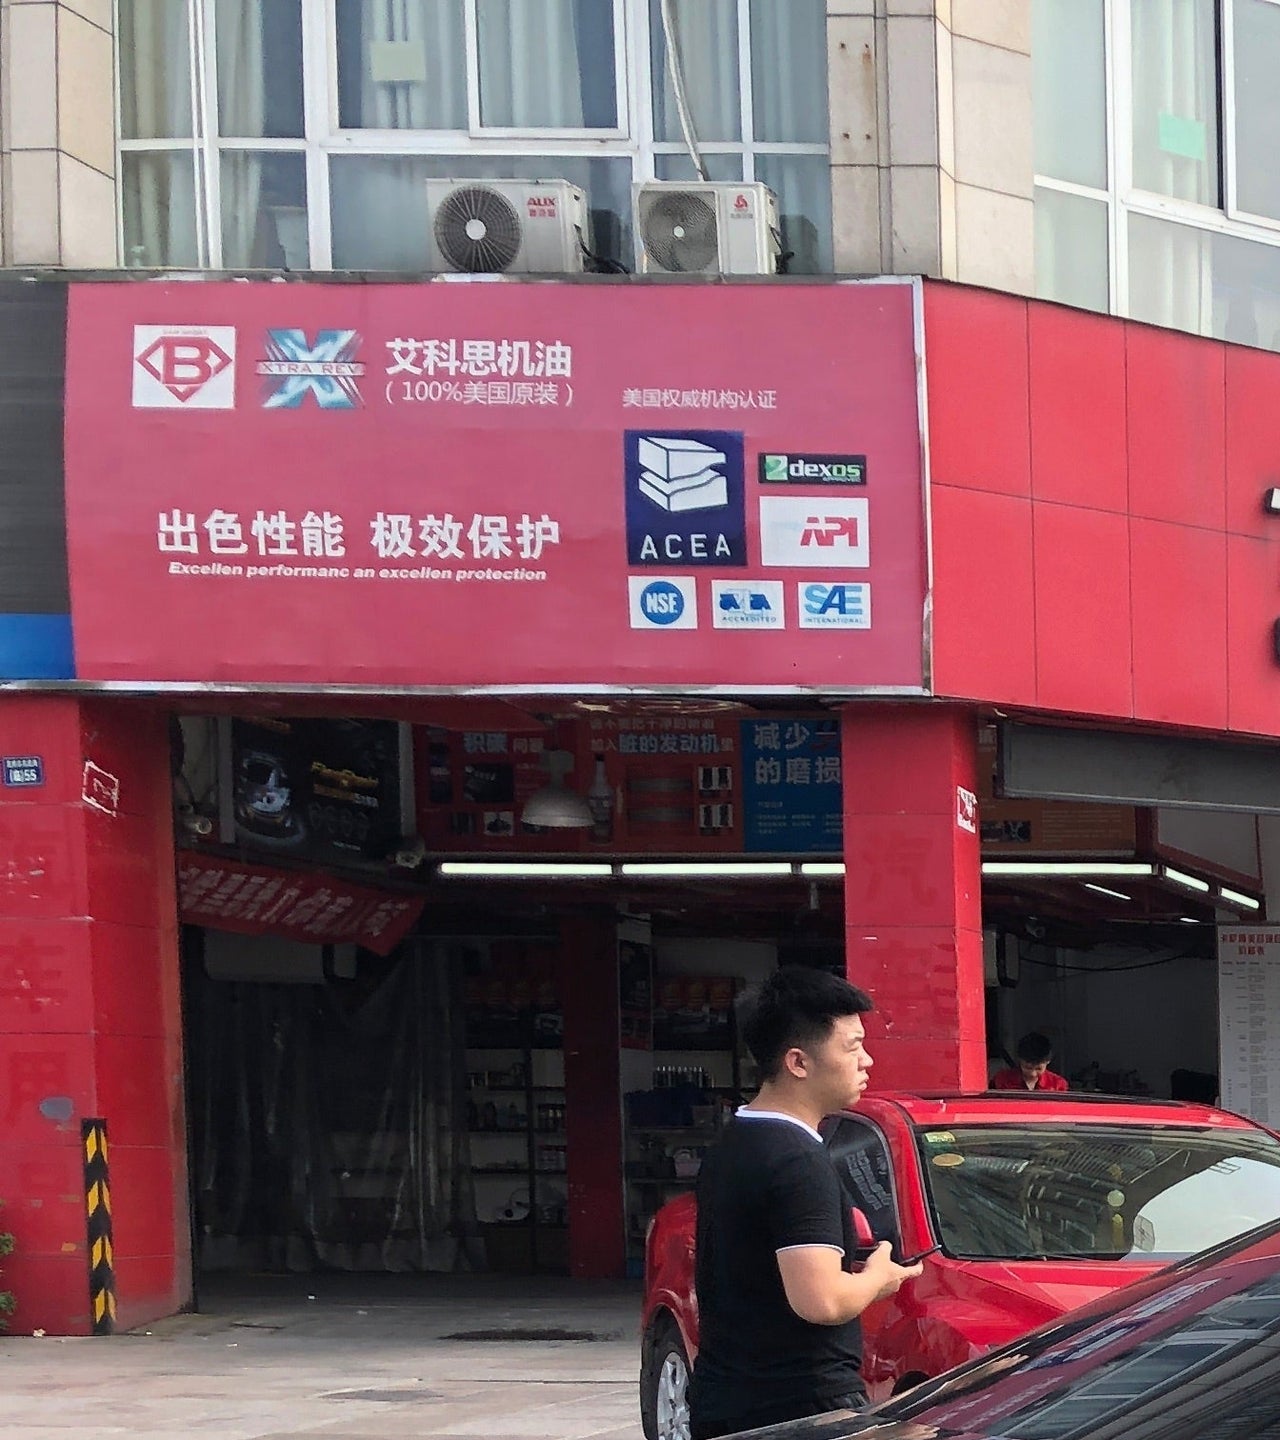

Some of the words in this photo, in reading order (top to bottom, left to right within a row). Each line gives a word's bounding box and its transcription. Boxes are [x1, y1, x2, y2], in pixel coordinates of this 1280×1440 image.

[262, 362, 312, 374] XTRA
[385, 337, 573, 378] 艾科思机油
[622, 387, 778, 410] 美国权威机构认证
[157, 508, 347, 558] 出色性能
[370, 511, 561, 561] 极效保护
[799, 516, 859, 547] API
[639, 533, 732, 560] ACEA
[168, 561, 244, 577] Excellen
[246, 563, 350, 580] performanc
[353, 566, 376, 579] an
[379, 566, 453, 581] excellen
[455, 567, 548, 583] protection
[804, 584, 864, 615] SAE
